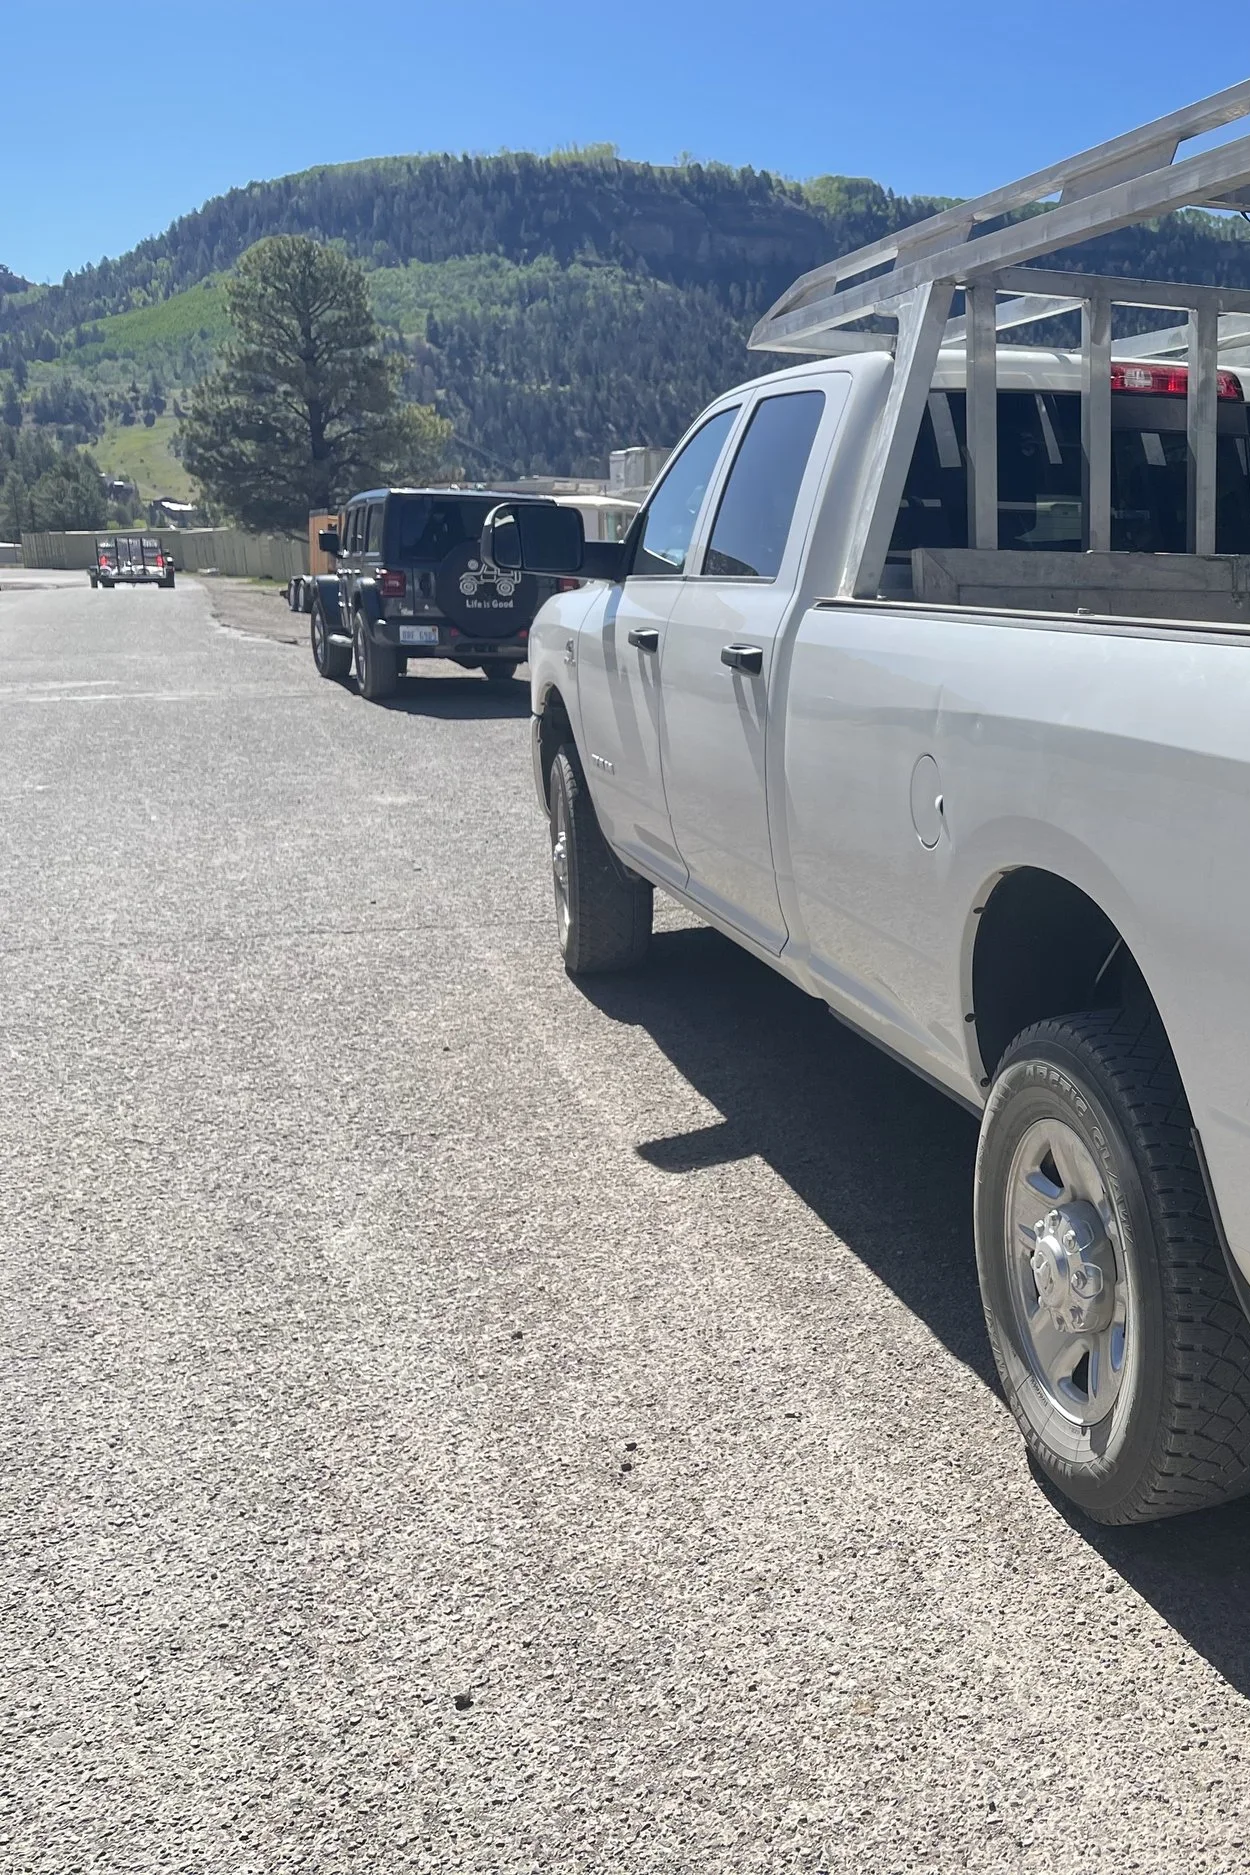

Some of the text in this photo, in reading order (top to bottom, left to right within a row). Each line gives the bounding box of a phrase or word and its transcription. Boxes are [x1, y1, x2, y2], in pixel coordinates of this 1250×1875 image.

[466, 599, 514, 608] Life is Good
[1025, 1064, 1134, 1244] ARCTIC CLAW
